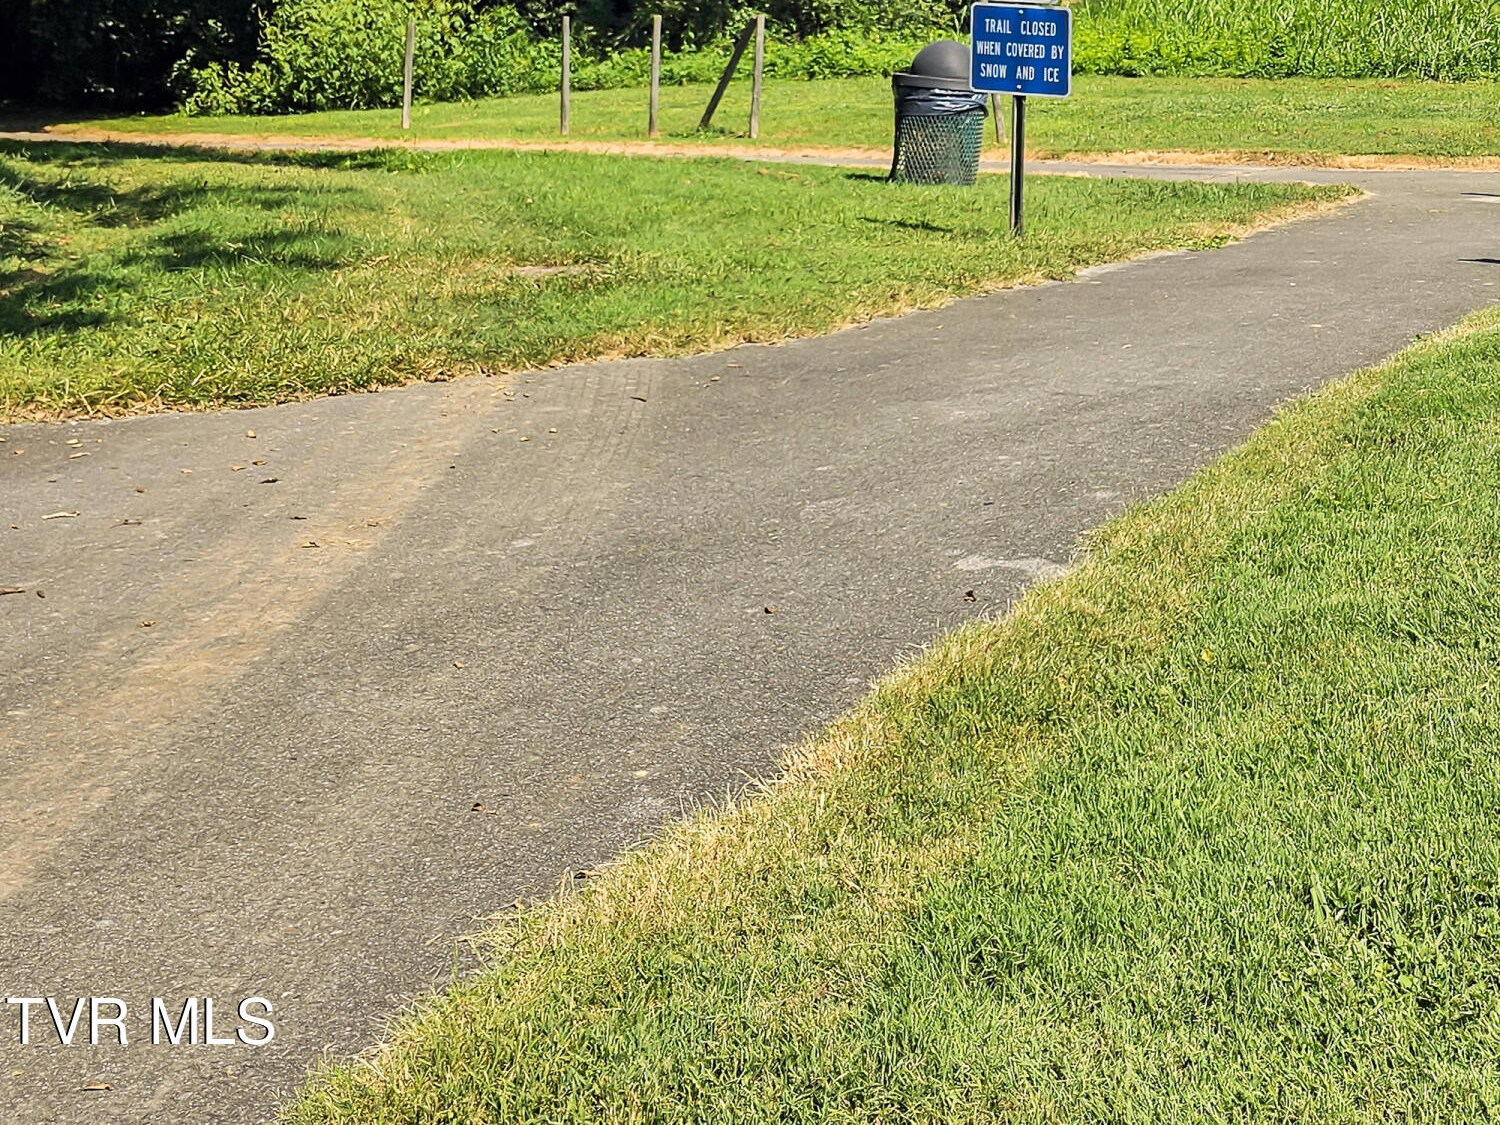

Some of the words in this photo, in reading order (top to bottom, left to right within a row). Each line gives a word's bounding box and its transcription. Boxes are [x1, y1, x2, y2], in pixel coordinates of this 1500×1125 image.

[984, 18, 1012, 34] TRAIL
[1020, 20, 1057, 37] CLOSED
[976, 40, 1001, 56] WHEN
[1006, 42, 1045, 58] COVERED
[1051, 45, 1064, 59] BY
[980, 63, 1007, 78] SNOW
[1016, 65, 1035, 81] AND
[1043, 67, 1060, 83] ICE
